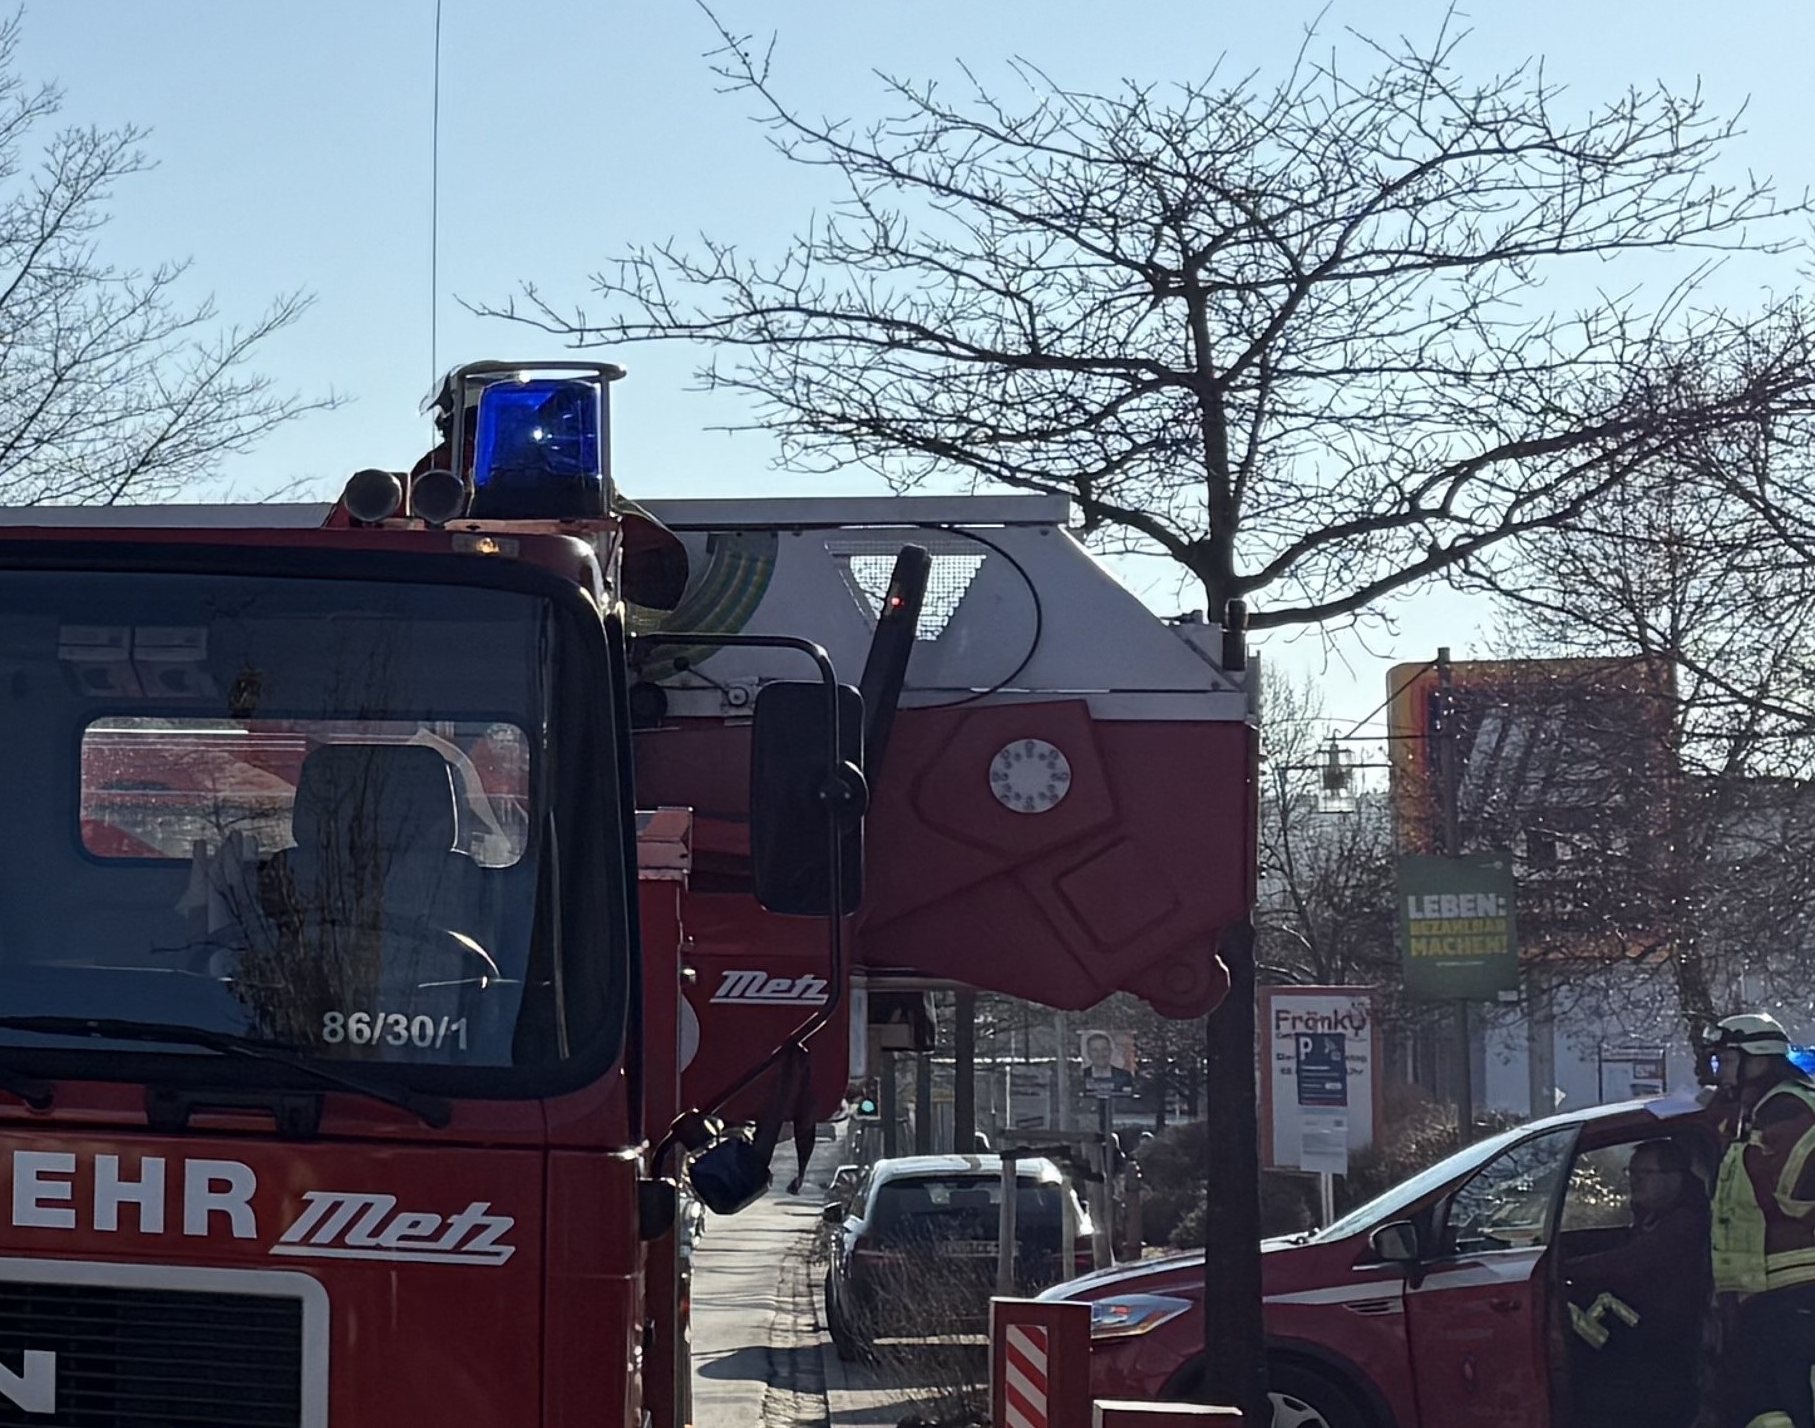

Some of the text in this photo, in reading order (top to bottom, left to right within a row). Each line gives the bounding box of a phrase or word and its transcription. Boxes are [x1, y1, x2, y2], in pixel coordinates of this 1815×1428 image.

[1407, 893, 1506, 919] LEBEN:
[1410, 935, 1507, 956] MACHEN!
[710, 970, 829, 1004] Metz
[322, 1011, 467, 1050] 86/30/1
[269, 1191, 516, 1265] Metz
